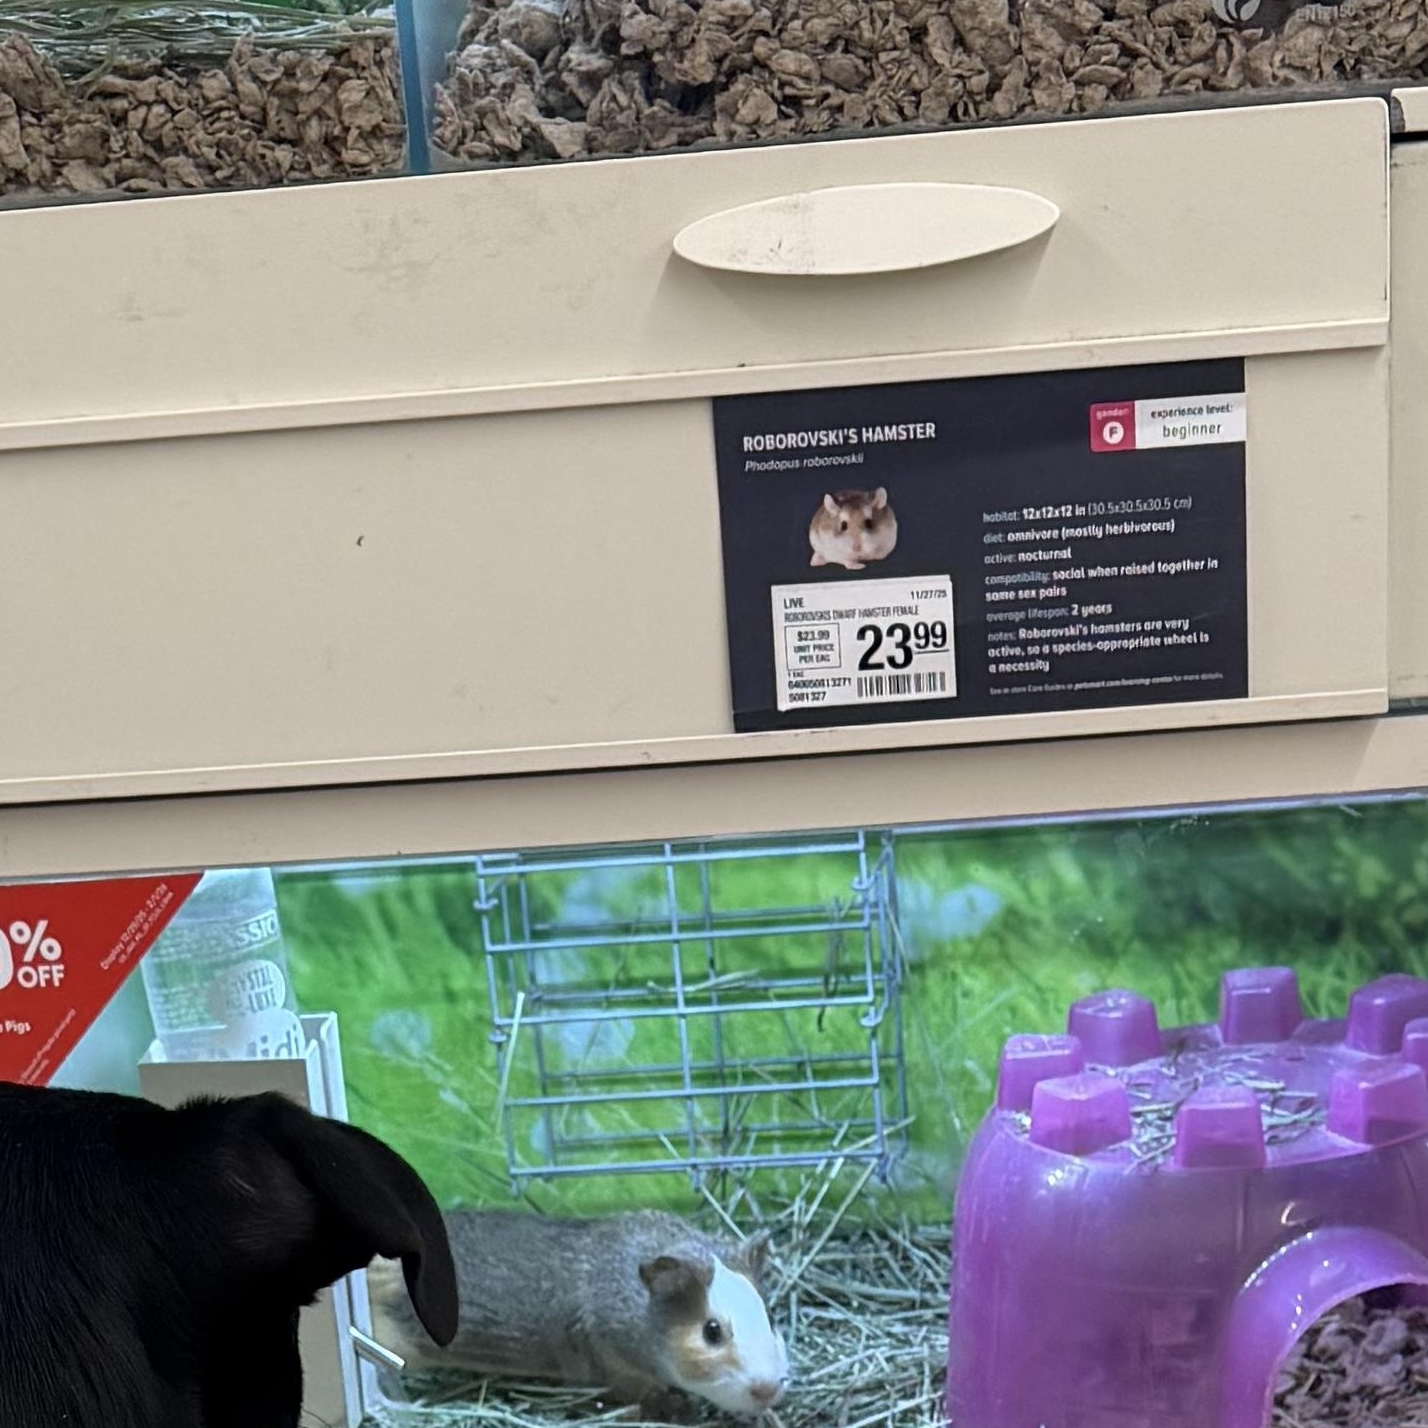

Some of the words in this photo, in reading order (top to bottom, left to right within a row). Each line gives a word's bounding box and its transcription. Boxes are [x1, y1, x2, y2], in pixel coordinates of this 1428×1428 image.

[1151, 405, 1203, 419] experience
[1206, 403, 1233, 415] level:
[743, 427, 858, 452] ROBOROVSKI'S
[862, 422, 936, 443] HAMSTER
[1109, 427, 1118, 438] F
[1163, 423, 1222, 440] beginner
[745, 458, 800, 472] Phodopus
[803, 453, 864, 467] roborovskii
[1023, 505, 1072, 521] 12x12x12
[1075, 504, 1085, 516] in
[1173, 496, 1192, 509] cm)
[1008, 529, 1059, 543] omnivore
[1061, 523, 1103, 541] (mostly
[1105, 519, 1175, 535] herbivorous)
[1018, 547, 1072, 562] nocturnal
[1053, 568, 1085, 580] social
[1087, 566, 1117, 578] when
[1120, 561, 1155, 575] raised
[1158, 558, 1204, 575] together
[1207, 557, 1219, 569] in
[1018, 589, 1036, 599] sex
[1039, 586, 1067, 600] pairs
[784, 598, 804, 609] LIVE
[858, 607, 891, 618] HAMSTER
[892, 605, 919, 616] FEMALE
[1071, 604, 1078, 616] 2
[1082, 603, 1112, 618] years
[1019, 624, 1088, 640] Roborovski's
[1090, 622, 1141, 635] hamsters
[1144, 620, 1162, 631] are
[1165, 618, 1189, 631] very
[813, 644, 834, 652] PRICE
[988, 645, 1025, 658] active,
[1027, 644, 1039, 655] so
[1042, 644, 1049, 654] a
[1053, 637, 1161, 654] species-appropriate
[1164, 633, 1197, 646] wheel
[1200, 632, 1209, 643] is
[989, 664, 996, 673] a
[999, 660, 1050, 674] necessity
[17, 964, 65, 988] OFF
[5, 1020, 31, 1034] Pigs
